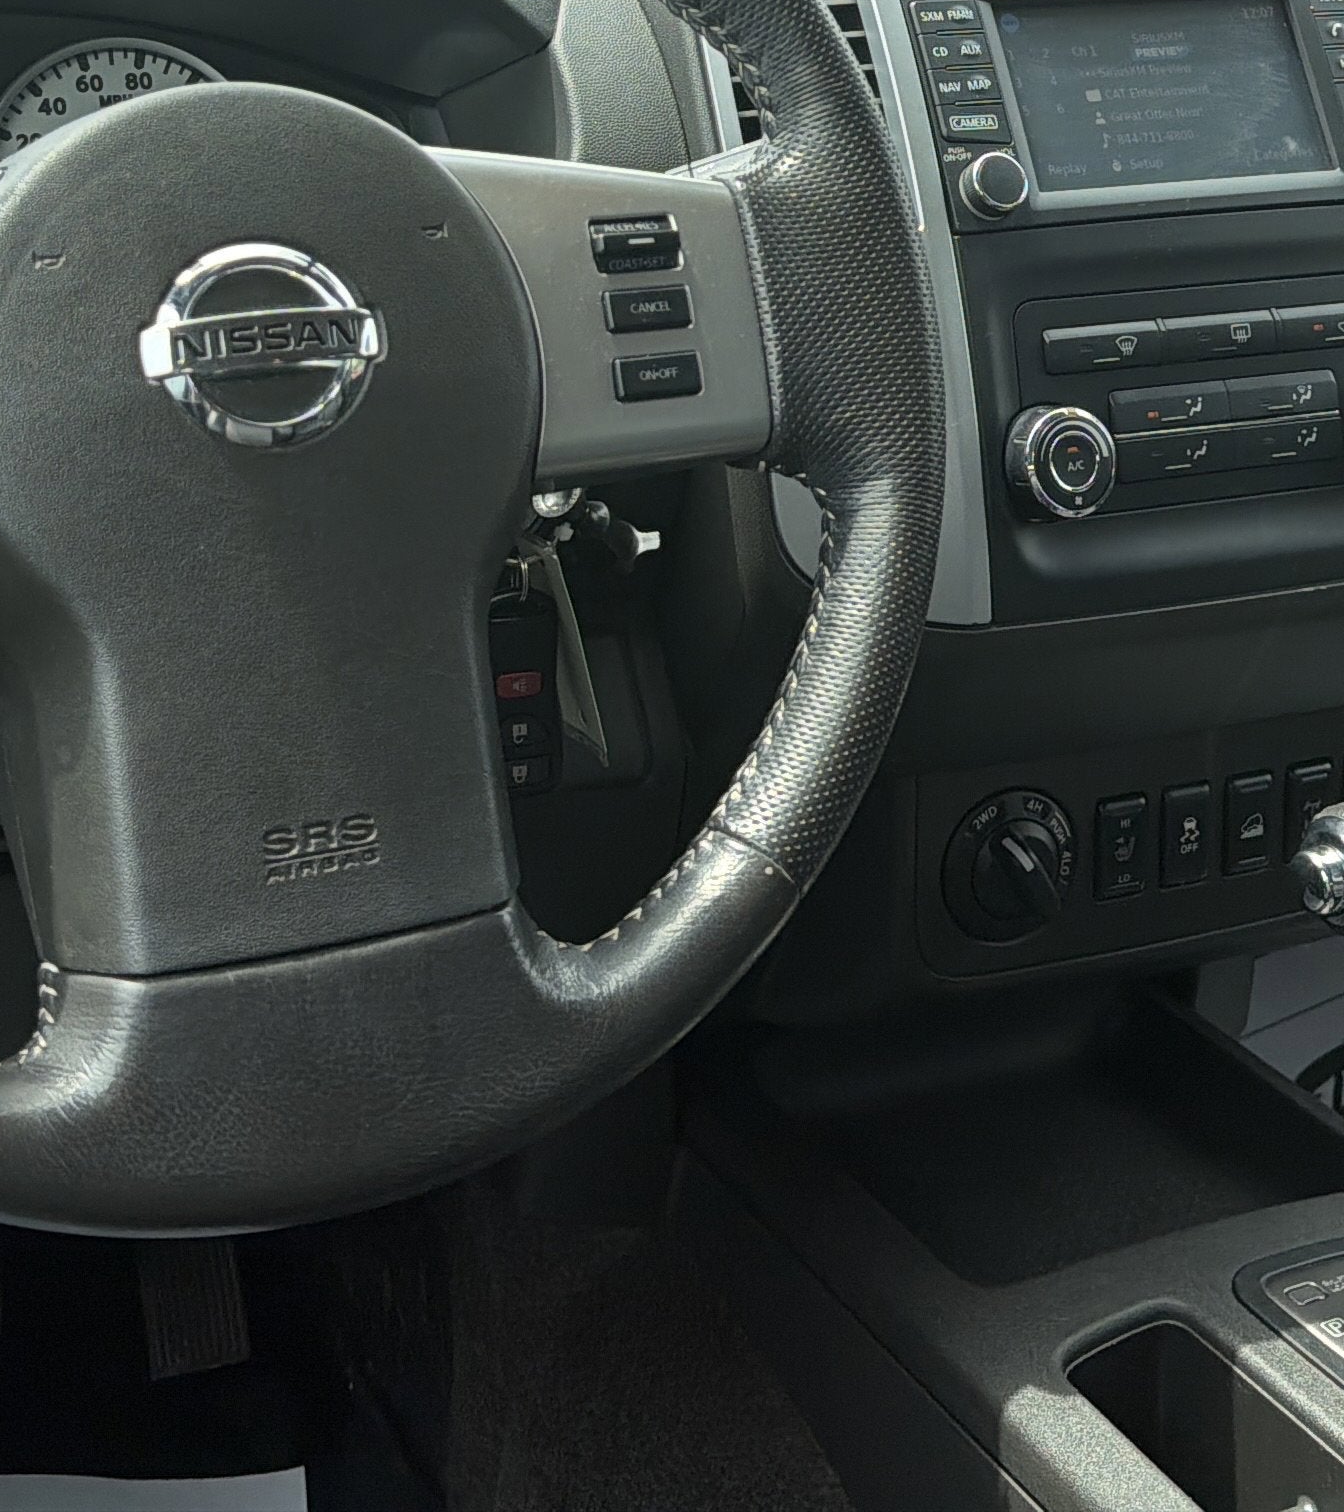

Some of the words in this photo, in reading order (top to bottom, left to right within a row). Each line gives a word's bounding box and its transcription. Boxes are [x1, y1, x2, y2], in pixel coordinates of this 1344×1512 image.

[920, 11, 944, 22] SXM
[932, 47, 949, 57] CD
[960, 44, 982, 56] AUX
[939, 81, 961, 93] NAV
[967, 79, 991, 91] MAP
[38, 97, 67, 116] 40
[76, 74, 103, 93] 60
[125, 72, 152, 91] 80
[952, 118, 995, 128] CAMERA
[630, 301, 671, 314] CANCEL
[173, 318, 357, 365] NISSAN
[1067, 458, 1085, 472] A/C
[1026, 799, 1044, 812] 4H
[972, 806, 997, 830] 2WD
[1120, 819, 1131, 829] HI
[1179, 842, 1198, 855] OFF
[1059, 851, 1072, 876] 4LO
[1117, 873, 1131, 884] LO
[1327, 1321, 1343, 1334] P
